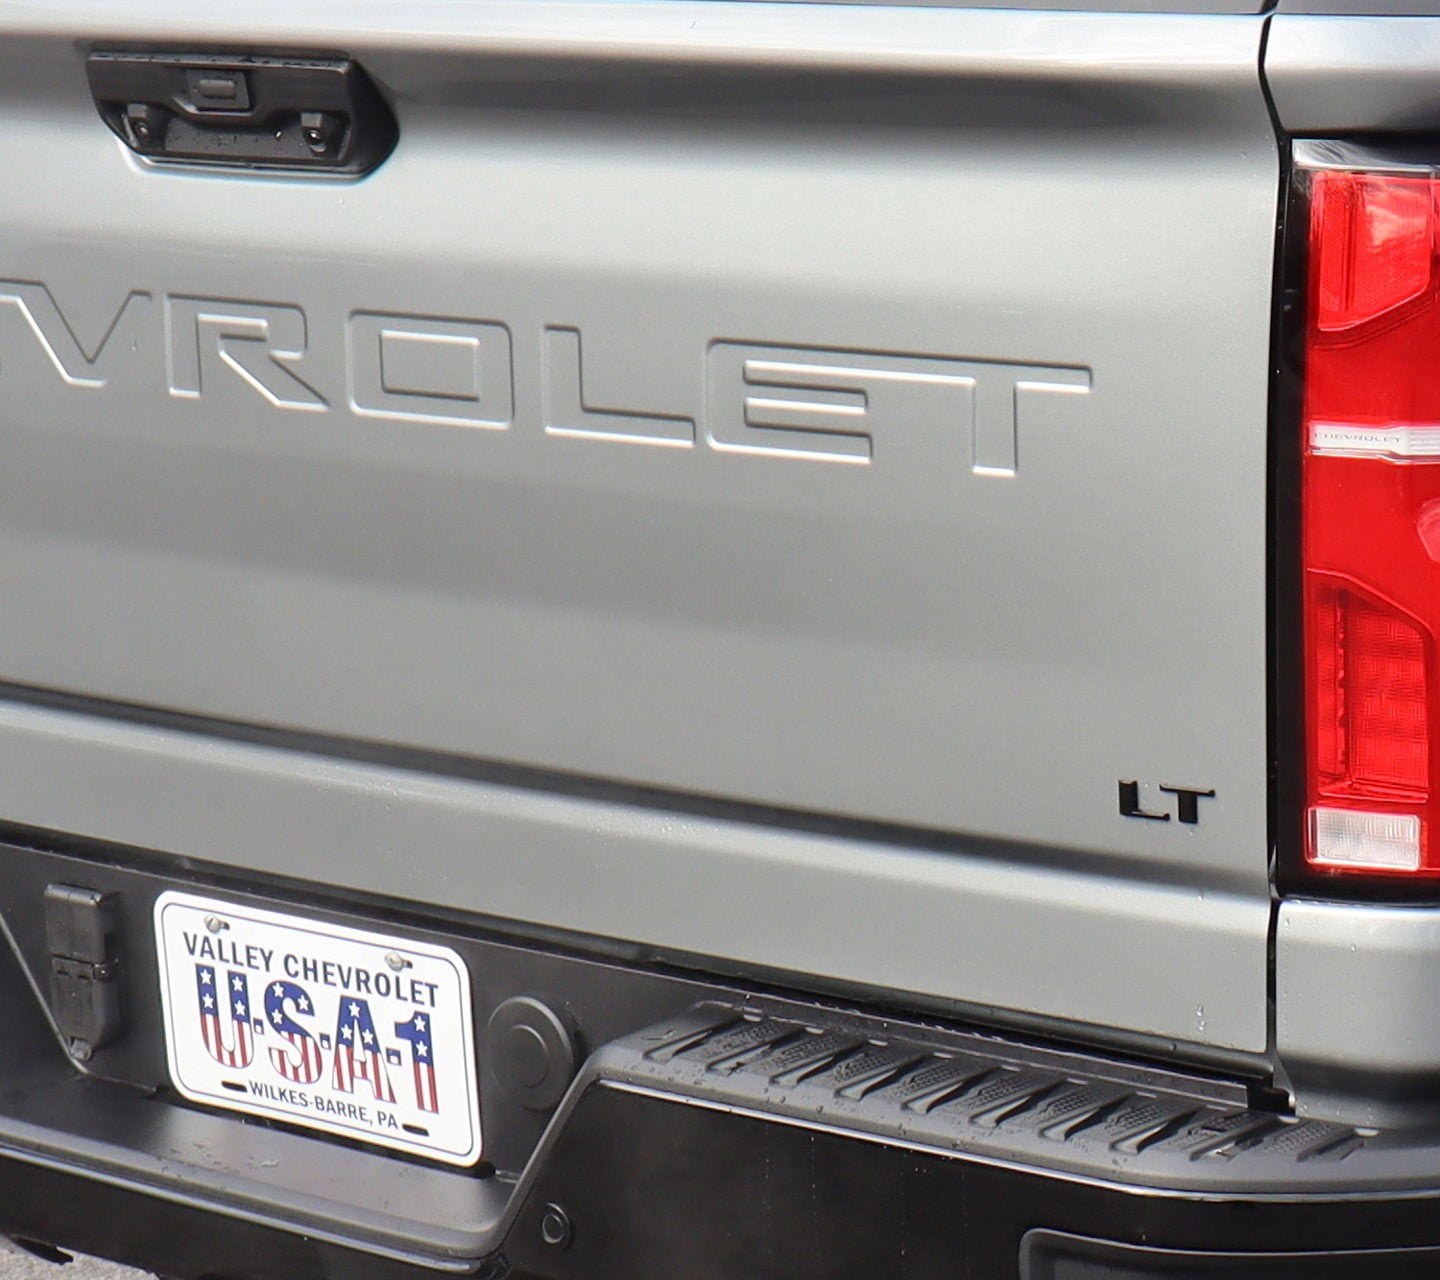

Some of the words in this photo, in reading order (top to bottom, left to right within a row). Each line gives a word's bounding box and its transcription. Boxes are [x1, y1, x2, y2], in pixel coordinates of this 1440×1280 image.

[1314, 432, 1403, 444] CHEVROLET
[1118, 779, 1216, 825] LT
[182, 930, 275, 973] VALLEY
[283, 953, 439, 1009] CHEVROLET
[248, 1079, 373, 1128] WILKES-BARRE,
[377, 1110, 399, 1130] PA
